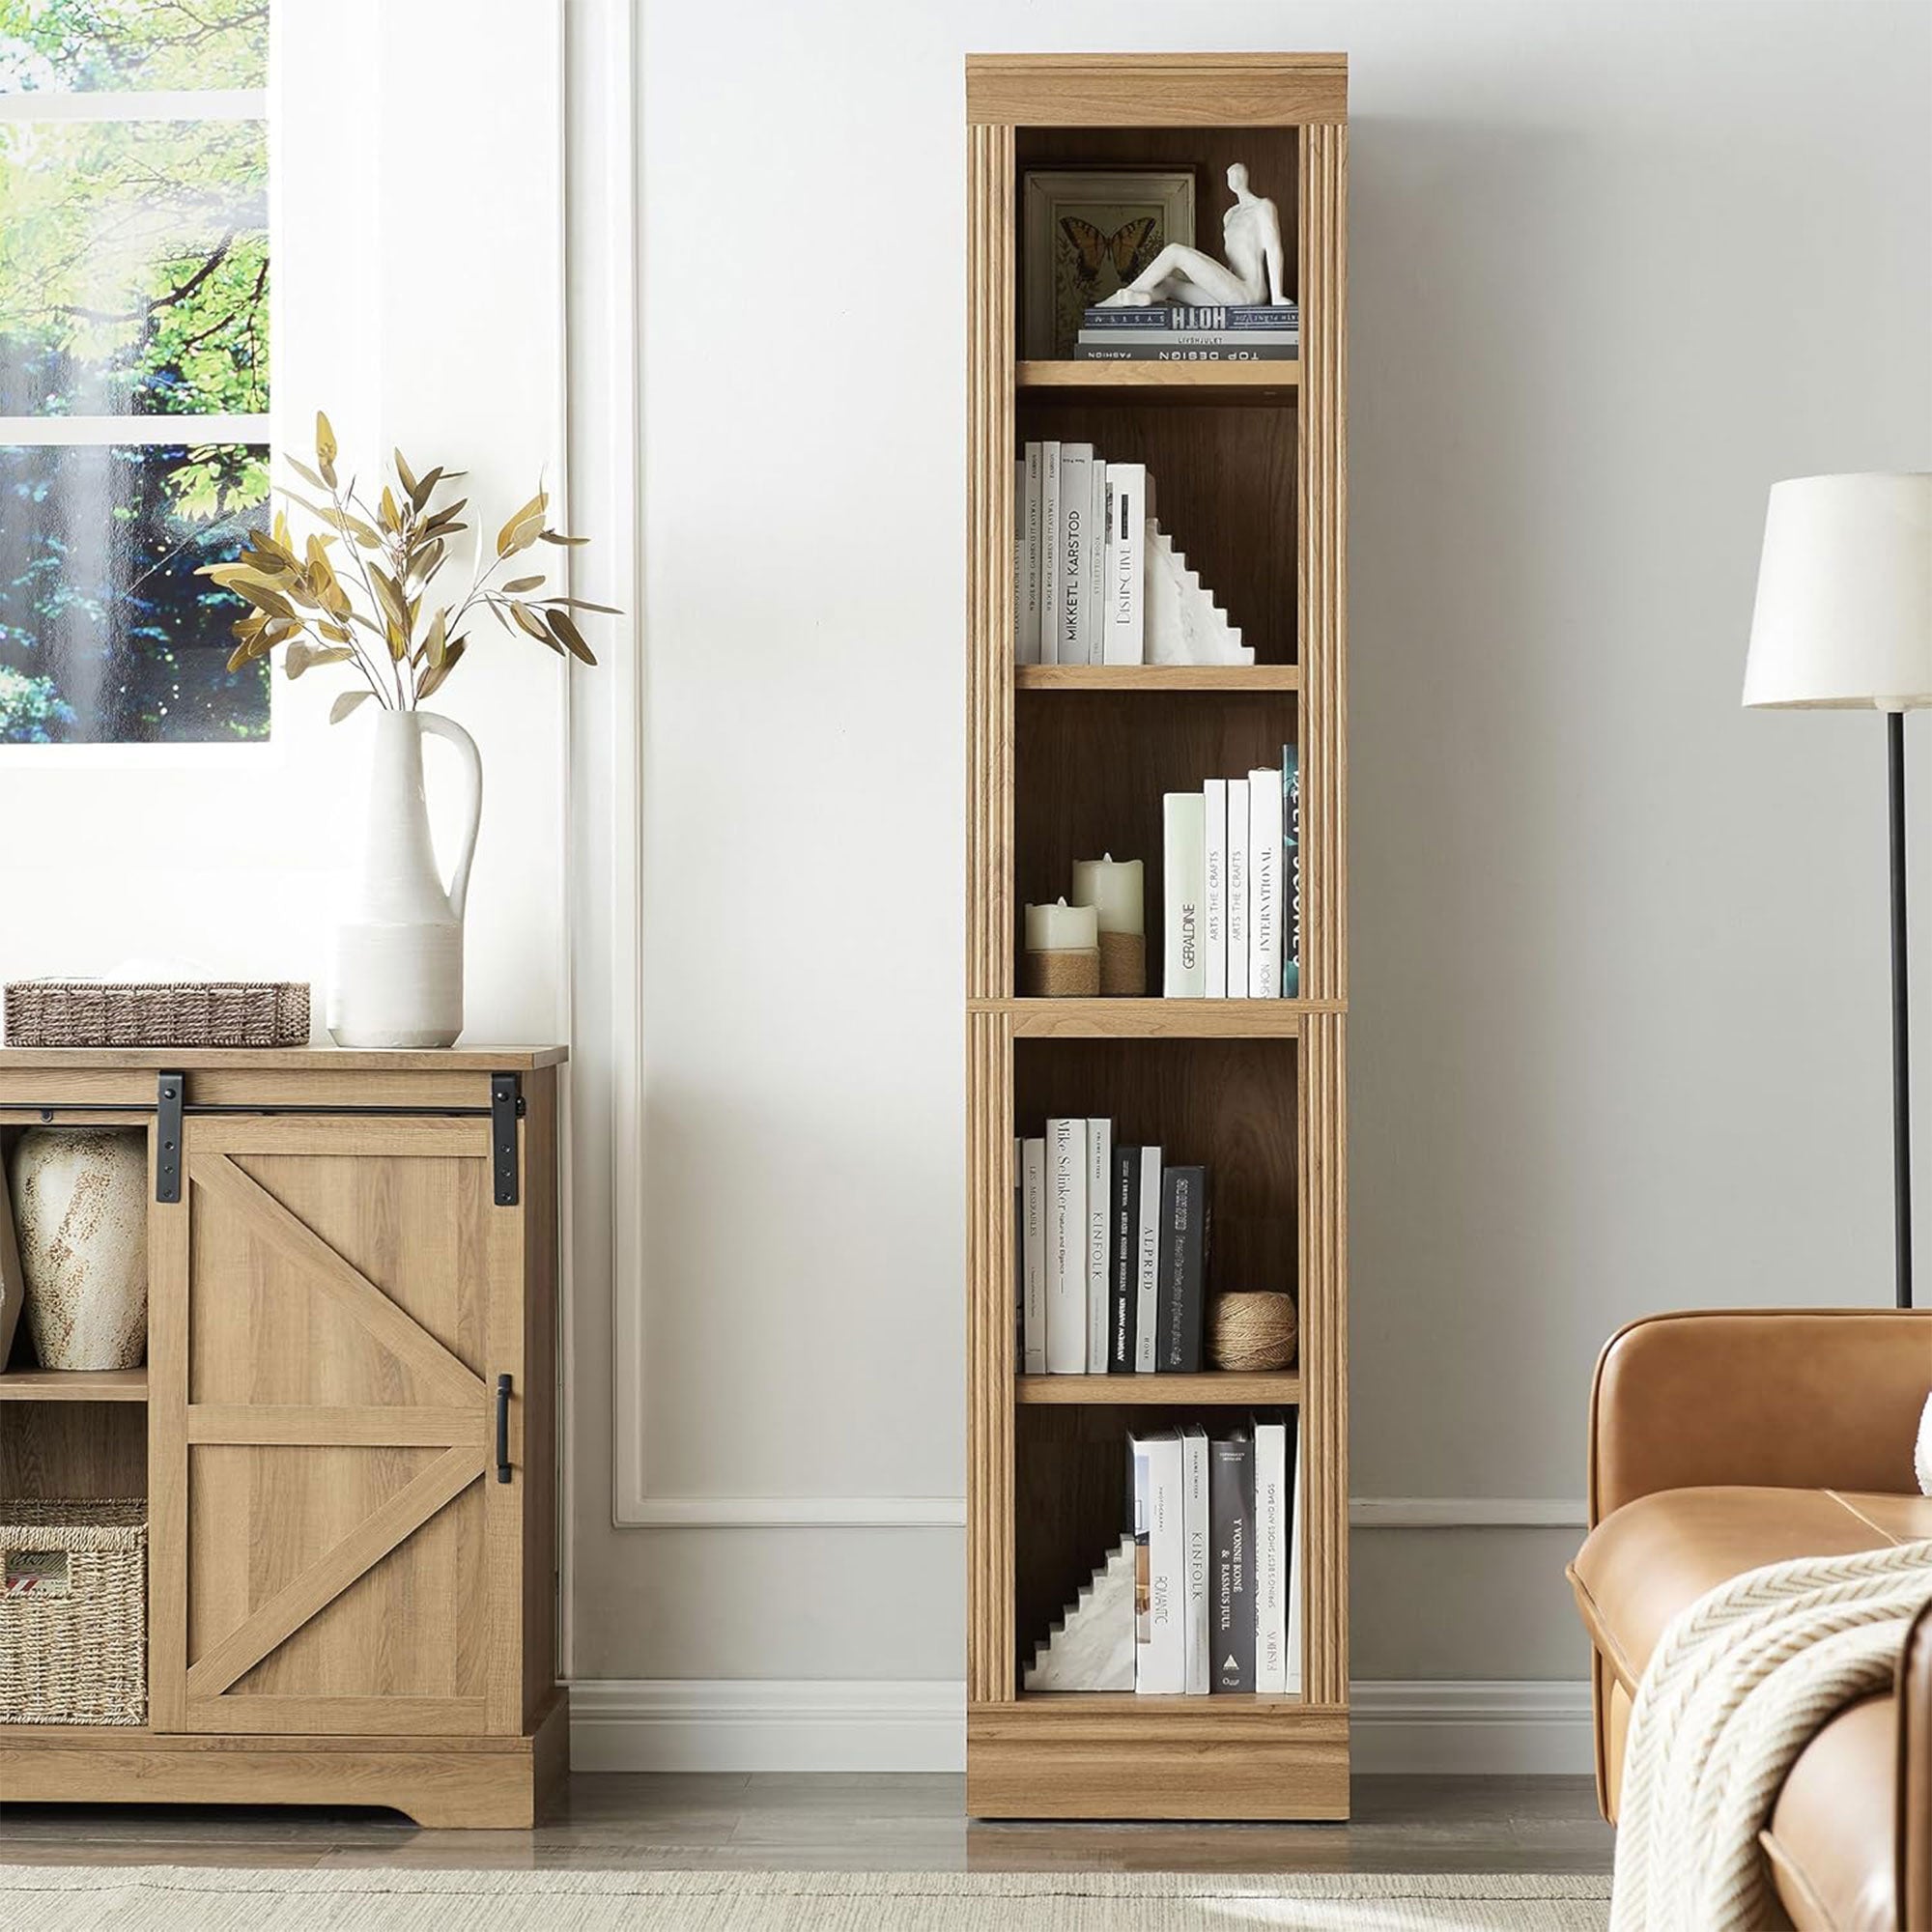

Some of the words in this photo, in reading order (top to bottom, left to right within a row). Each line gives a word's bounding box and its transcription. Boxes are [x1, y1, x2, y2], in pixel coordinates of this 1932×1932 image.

[1172, 307, 1226, 329] HOTH
[1159, 351, 1218, 360] DESIGN
[1228, 352, 1259, 360] TOP
[1066, 510, 1080, 576] KARSTOD
[1065, 581, 1079, 640] MIKKETL
[1209, 850, 1219, 889] CRAFTS
[1232, 850, 1241, 889] CRAFTS
[1209, 893, 1219, 912] THE
[1232, 893, 1241, 912] THE
[1181, 903, 1195, 970] GERALDINE
[1209, 916, 1219, 942] ARTS
[1232, 916, 1241, 942] ARTS
[1058, 1121, 1071, 1151] Mike
[1058, 1154, 1071, 1210] Selinker
[1092, 1212, 1103, 1280] KINFOLK
[1191, 1532, 1204, 1600] KINFOLK
[1221, 1548, 1231, 1559] &
[1221, 1564, 1231, 1604] RASMUS
[1220, 1605, 1231, 1631] JUUL
